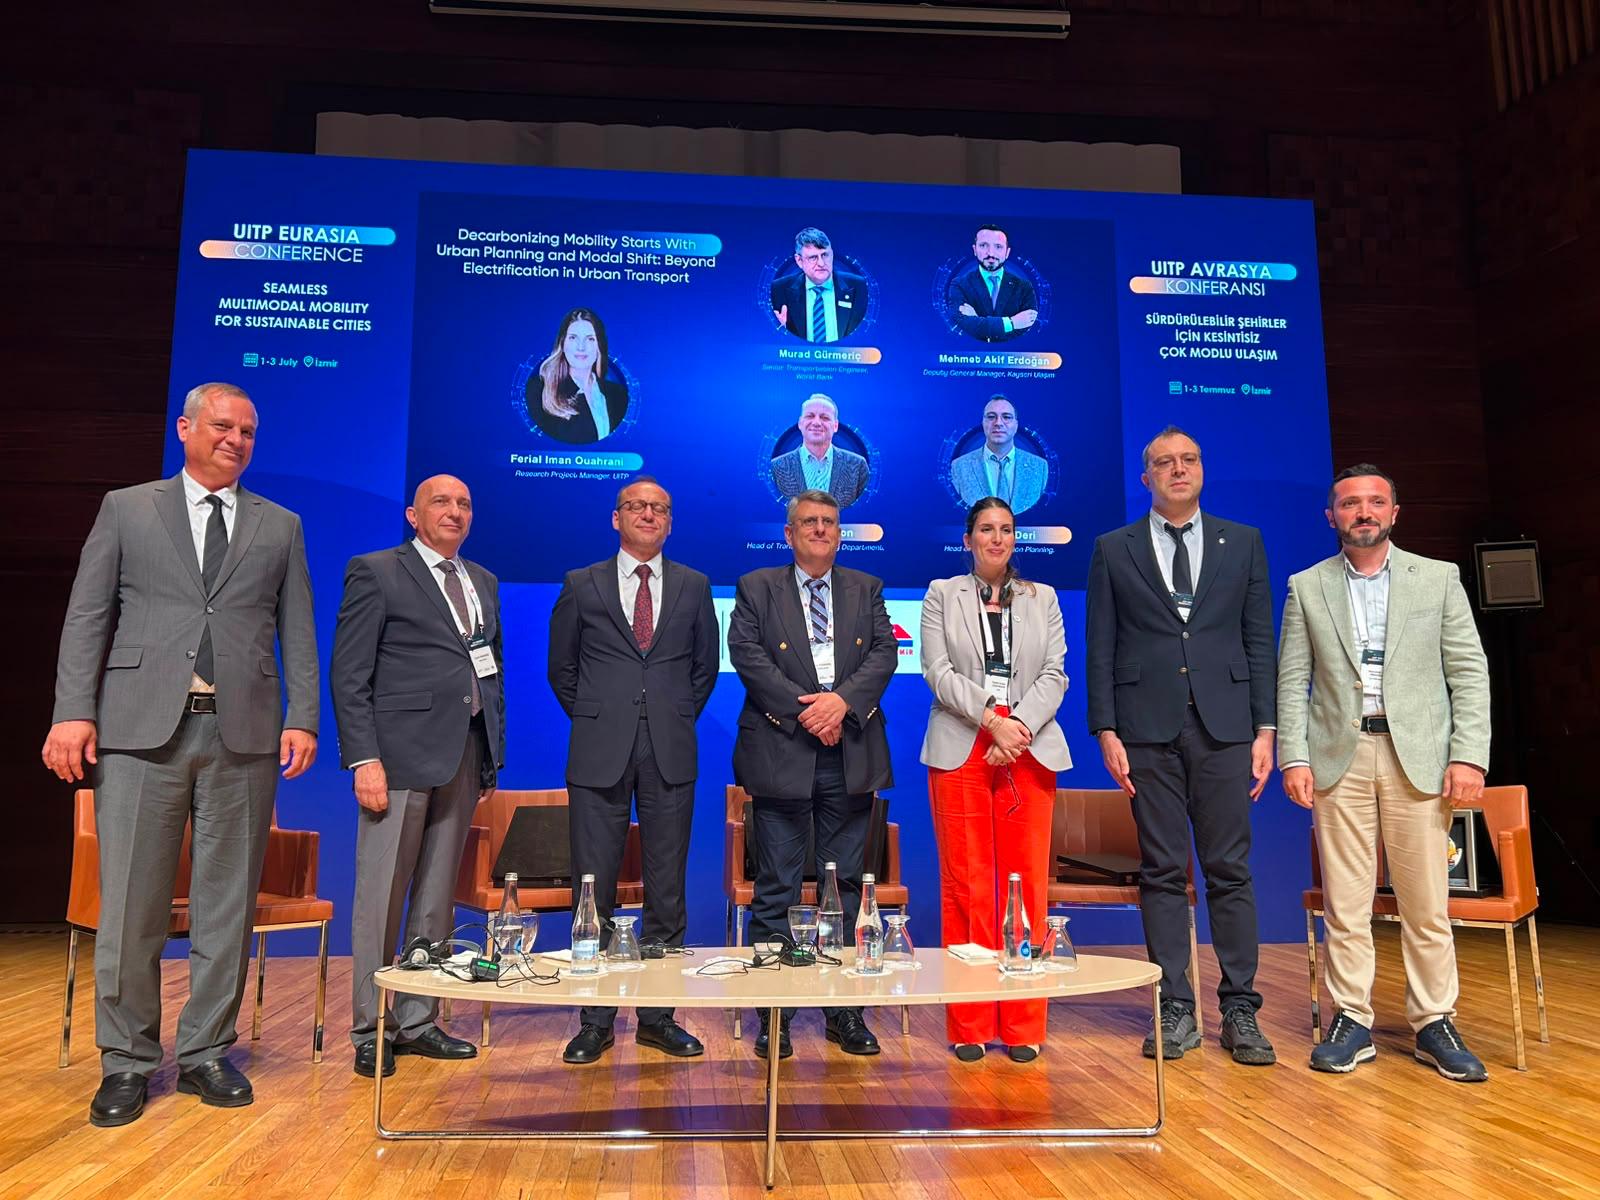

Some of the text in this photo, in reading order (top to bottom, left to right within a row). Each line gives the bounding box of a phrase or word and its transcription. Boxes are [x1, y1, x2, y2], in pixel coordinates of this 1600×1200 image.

[233, 223, 361, 244] UITP EURASIA
[458, 228, 696, 250] Decarbonizing Mobility Starts With
[234, 243, 363, 263] CONFERENCE
[436, 243, 716, 269] Urban Planning and Modal Shift: Beyond
[463, 262, 690, 285] Electrification in Urban Transport
[1151, 260, 1272, 279] UITP AVRASYA
[263, 282, 329, 296] SEAMLESS
[1166, 279, 1266, 296] KONFERANSI
[218, 298, 370, 314] MULTIMODAL MOBILITY
[215, 315, 372, 332] FOR SUSTAINABLE CITIES
[1145, 312, 1288, 329] SÜRDÜRÜLEBİLİR ŞEHİRLER
[1175, 329, 1260, 344] İÇİN KESİNTİSİZ
[779, 349, 862, 362] Murad Gürmeriç
[939, 354, 1050, 367] Mehmet Akif Erdoğan
[1159, 347, 1278, 362] ÇOK MODLU ULAŞIM
[260, 357, 298, 368] 1-3 July
[923, 369, 948, 377] Deputy
[949, 369, 975, 377] General
[1184, 385, 1236, 394] 1-3 Temmuz
[510, 454, 624, 467] Ferial Iman Ouahrani
[514, 469, 549, 478] Research
[550, 470, 577, 479] Project
[1015, 530, 1036, 540] Deri
[766, 542, 774, 550] of
